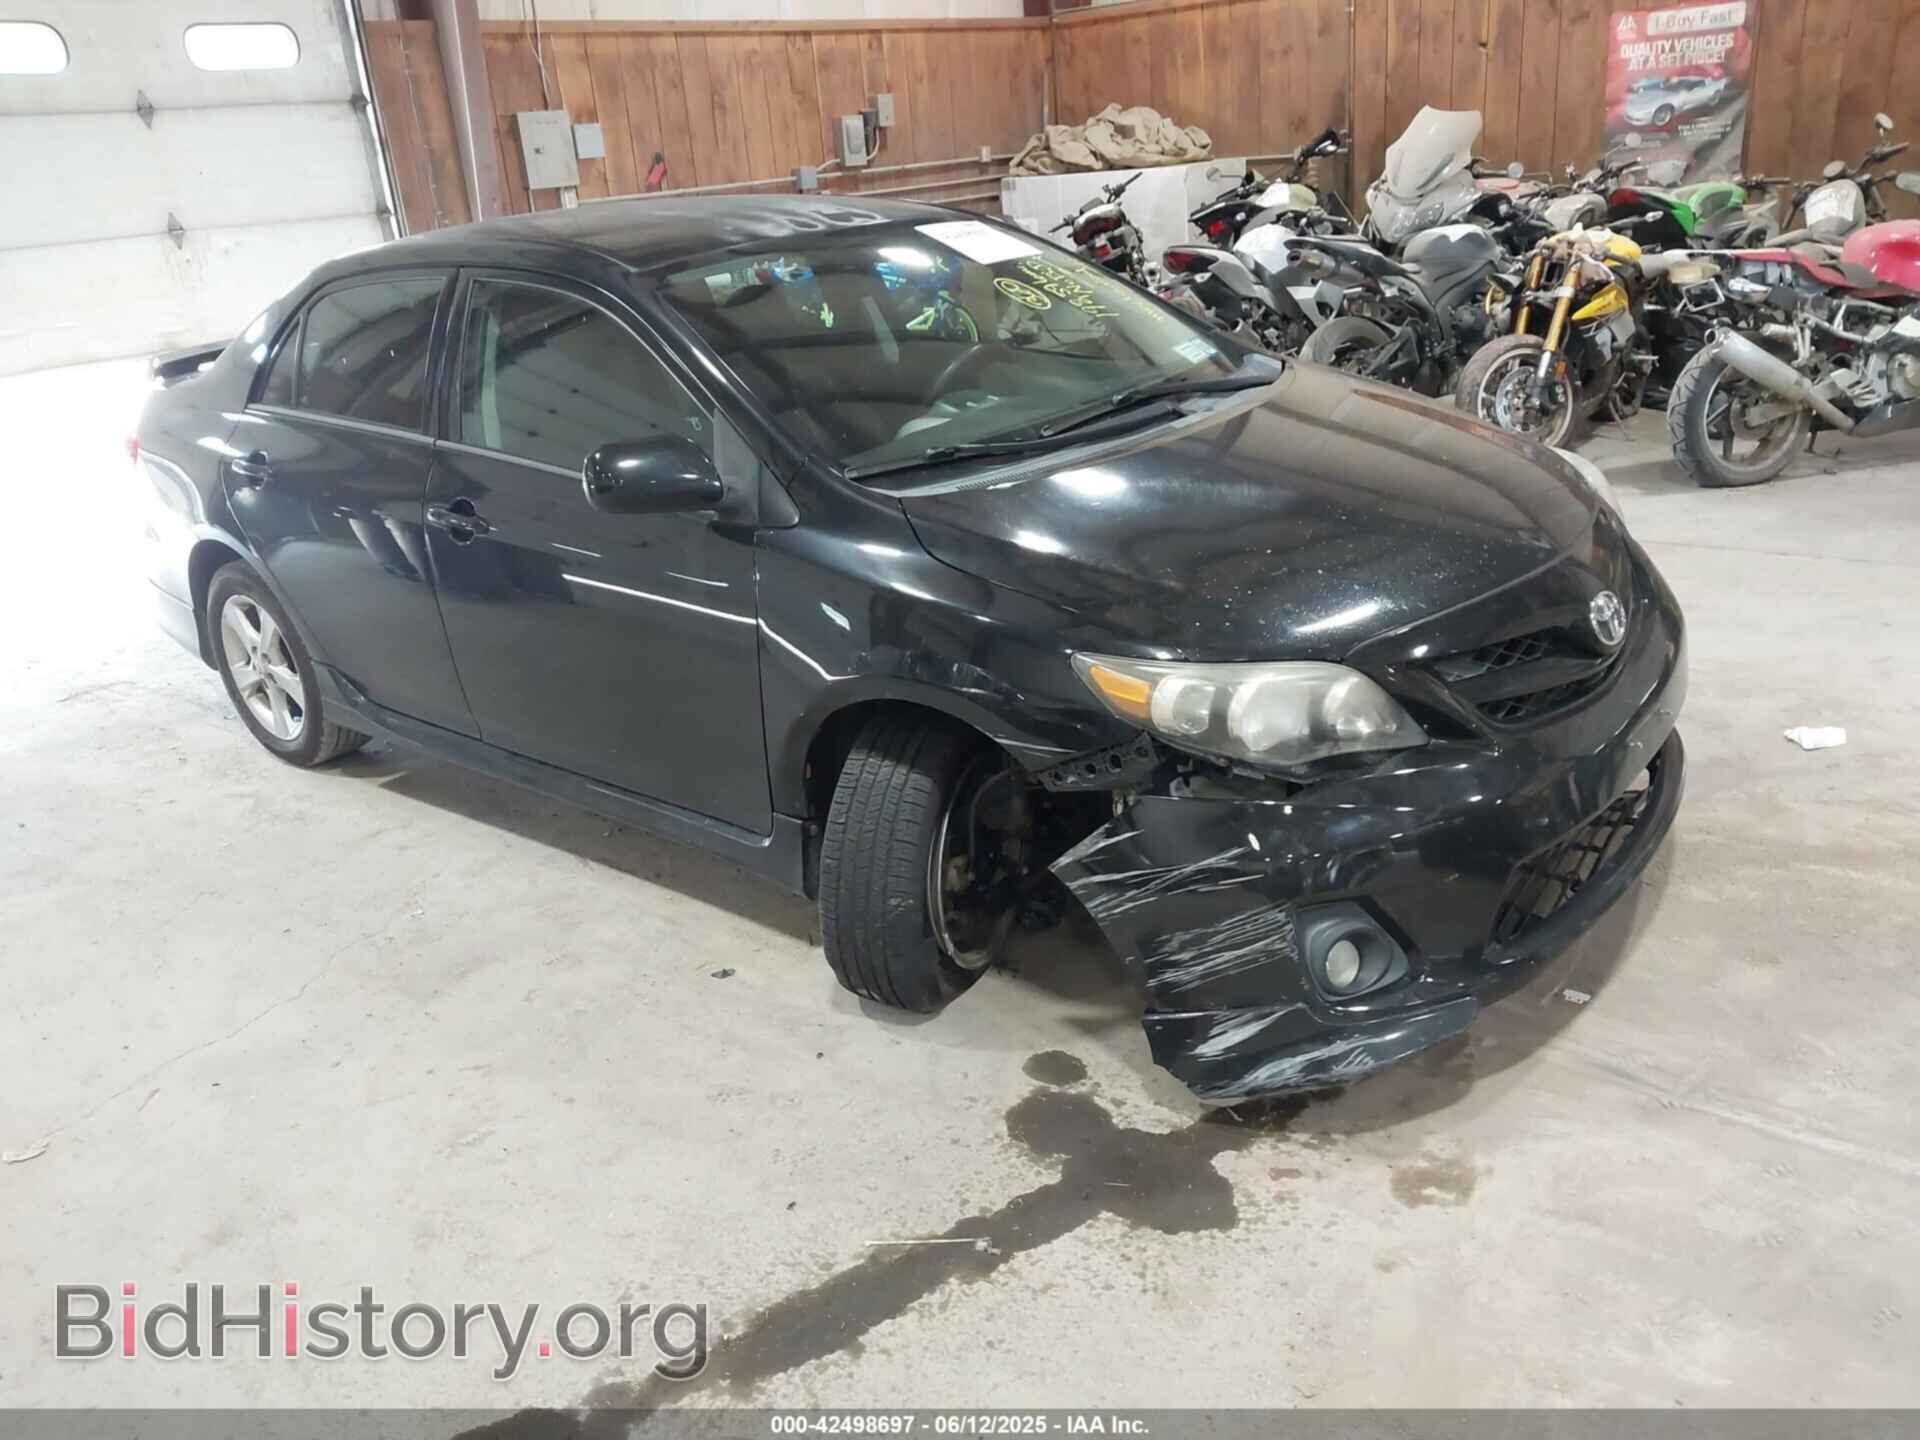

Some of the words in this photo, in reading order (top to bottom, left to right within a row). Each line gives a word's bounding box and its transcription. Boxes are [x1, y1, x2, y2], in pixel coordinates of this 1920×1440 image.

[1700, 7, 1733, 25] Fast
[1620, 39, 1672, 59] QUALITY
[1673, 33, 1735, 54] VEHICLES
